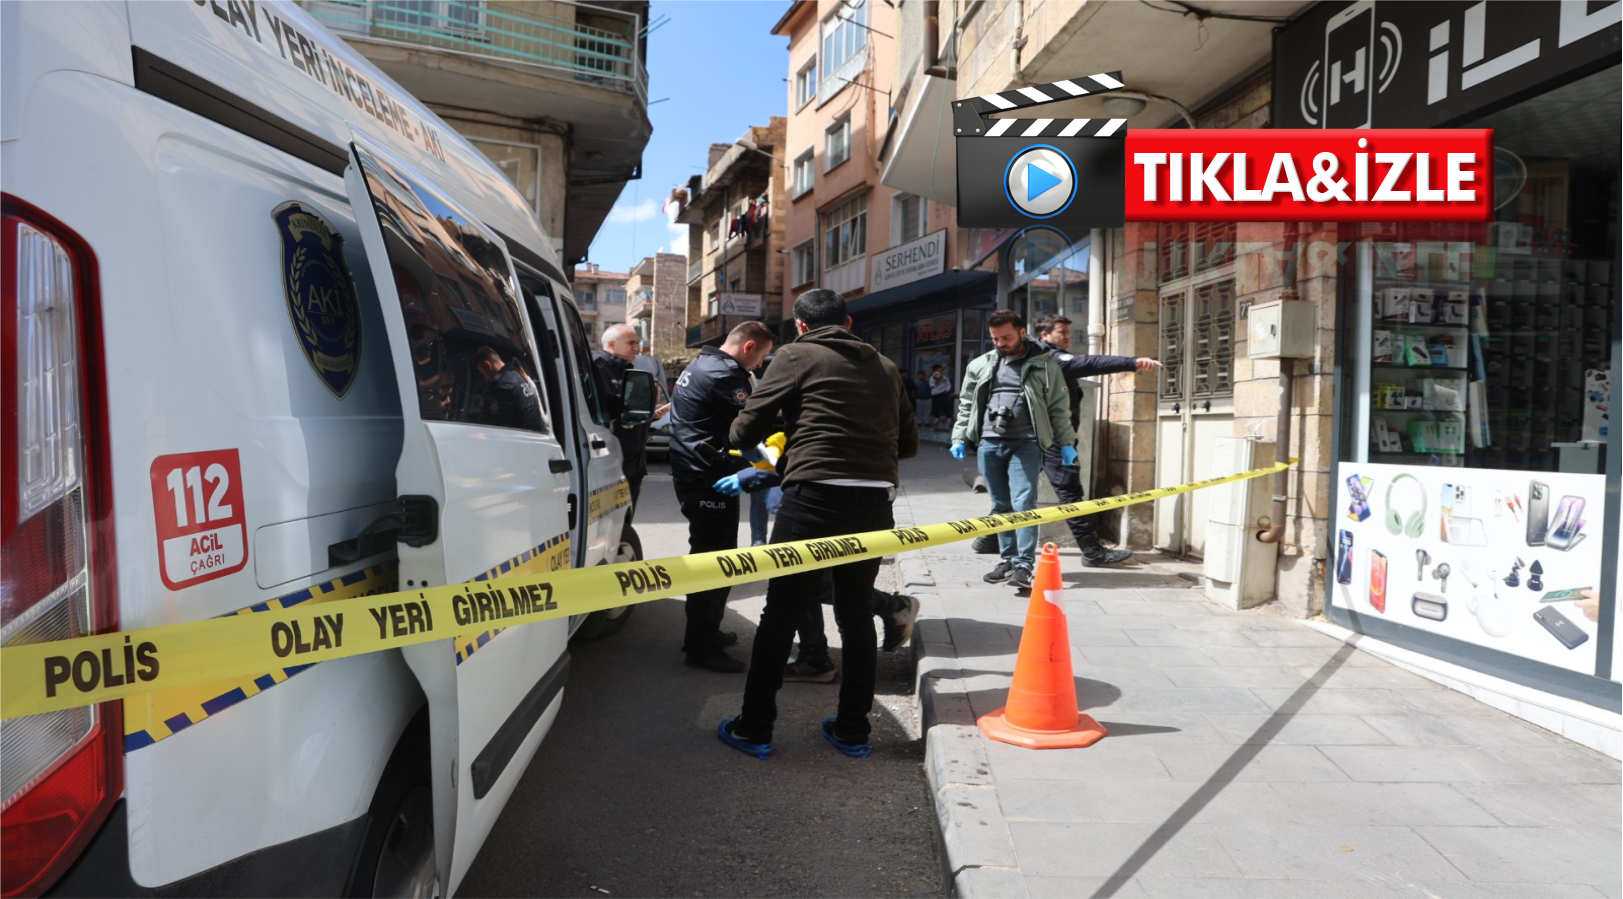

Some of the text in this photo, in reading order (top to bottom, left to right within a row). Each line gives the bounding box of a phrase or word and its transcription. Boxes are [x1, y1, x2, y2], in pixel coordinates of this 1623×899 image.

[193, 0, 263, 44] LAY
[885, 234, 940, 272] SERHENDİ
[166, 462, 233, 528] 112
[190, 553, 226, 576] ÇAĞRI
[44, 635, 160, 698] POLİS
[270, 613, 344, 658] OLAY
[368, 592, 434, 640] YERİ
[451, 582, 558, 627] GİRİLMEZ
[614, 562, 672, 597] POLİS
[716, 554, 758, 579] OLAY
[762, 543, 804, 569] YERİ
[804, 536, 868, 562] GİRİLMEZ
